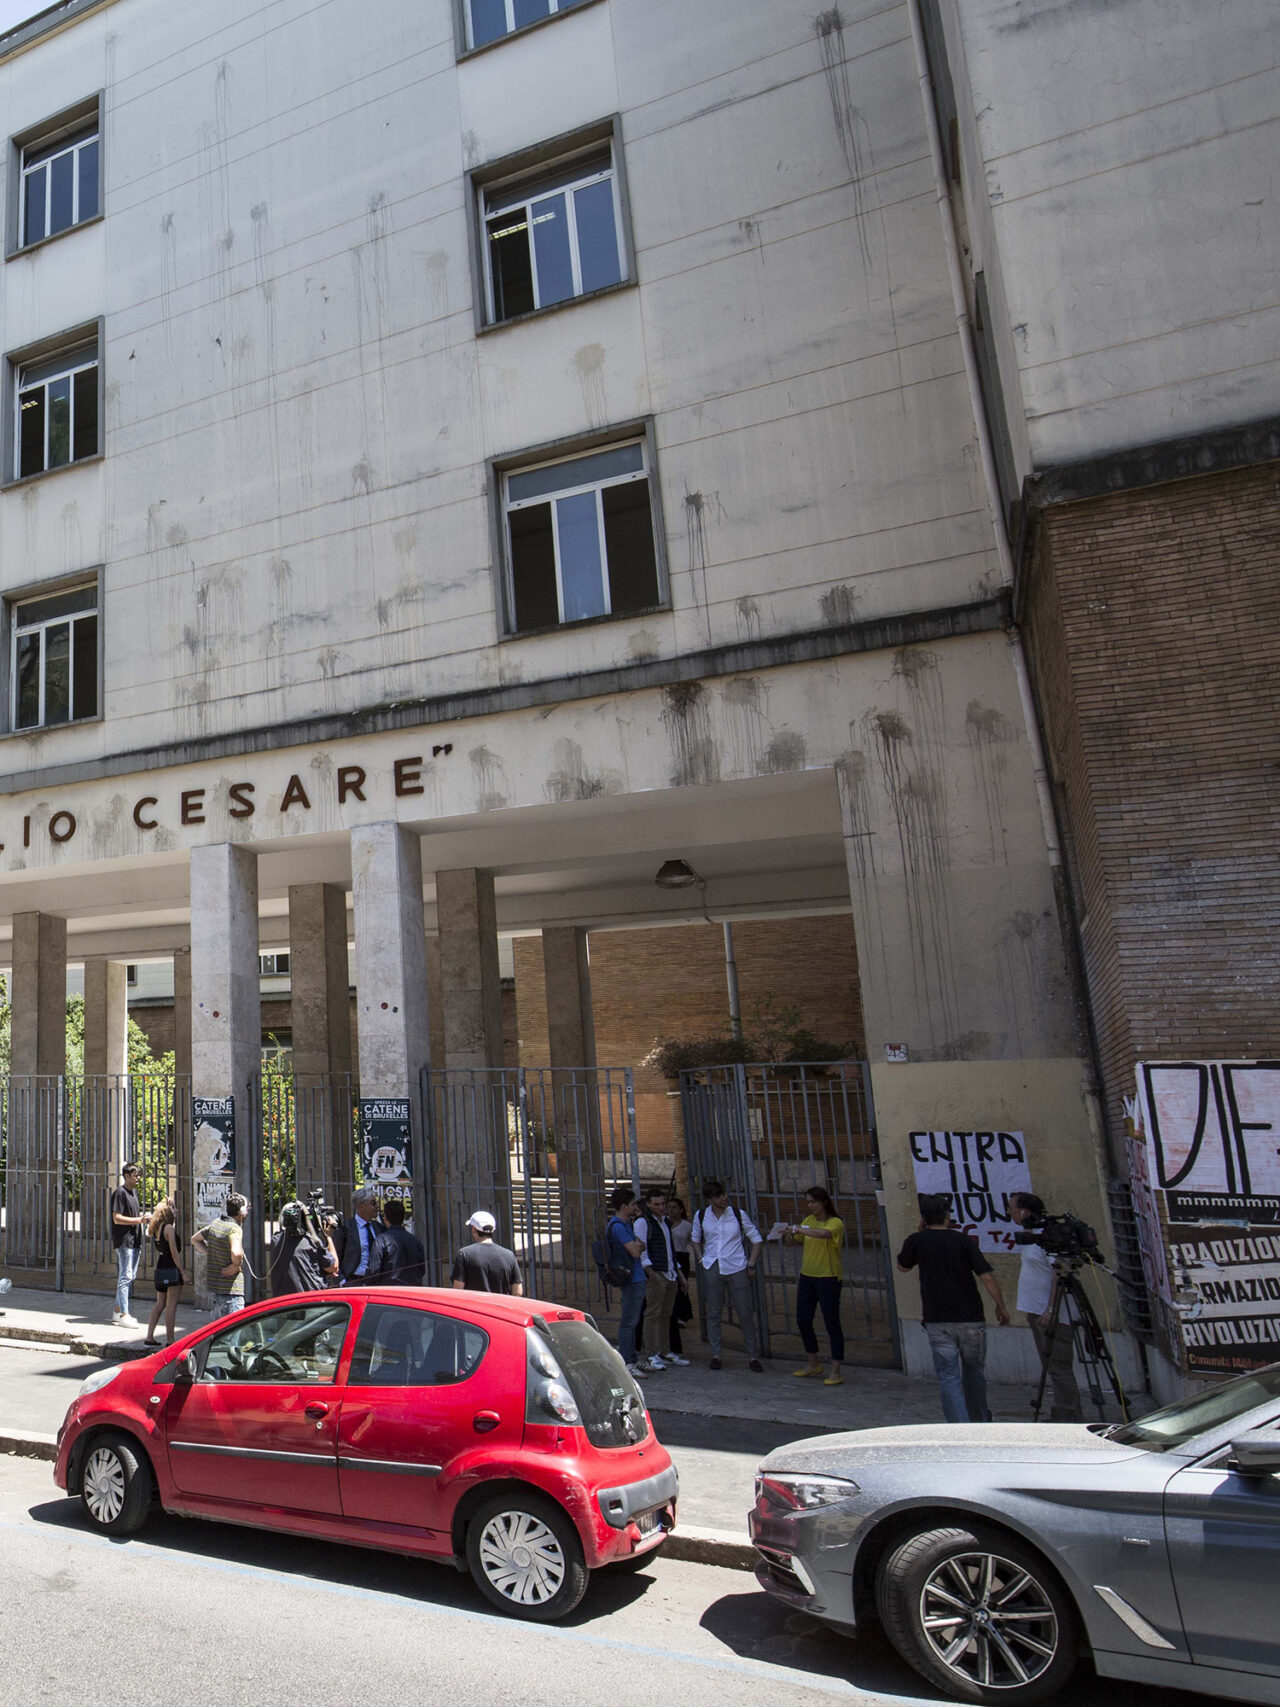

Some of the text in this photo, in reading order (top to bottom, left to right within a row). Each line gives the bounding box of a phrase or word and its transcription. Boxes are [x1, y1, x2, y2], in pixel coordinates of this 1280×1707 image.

[194, 1101, 232, 1110] CATENE
[364, 1104, 408, 1114] CATENE
[1142, 1061, 1280, 1195] DIF
[909, 1131, 1024, 1163] ENTRA
[377, 1155, 395, 1168] FN
[949, 1163, 989, 1192] IN
[1176, 1277, 1280, 1305] RMAZIO
